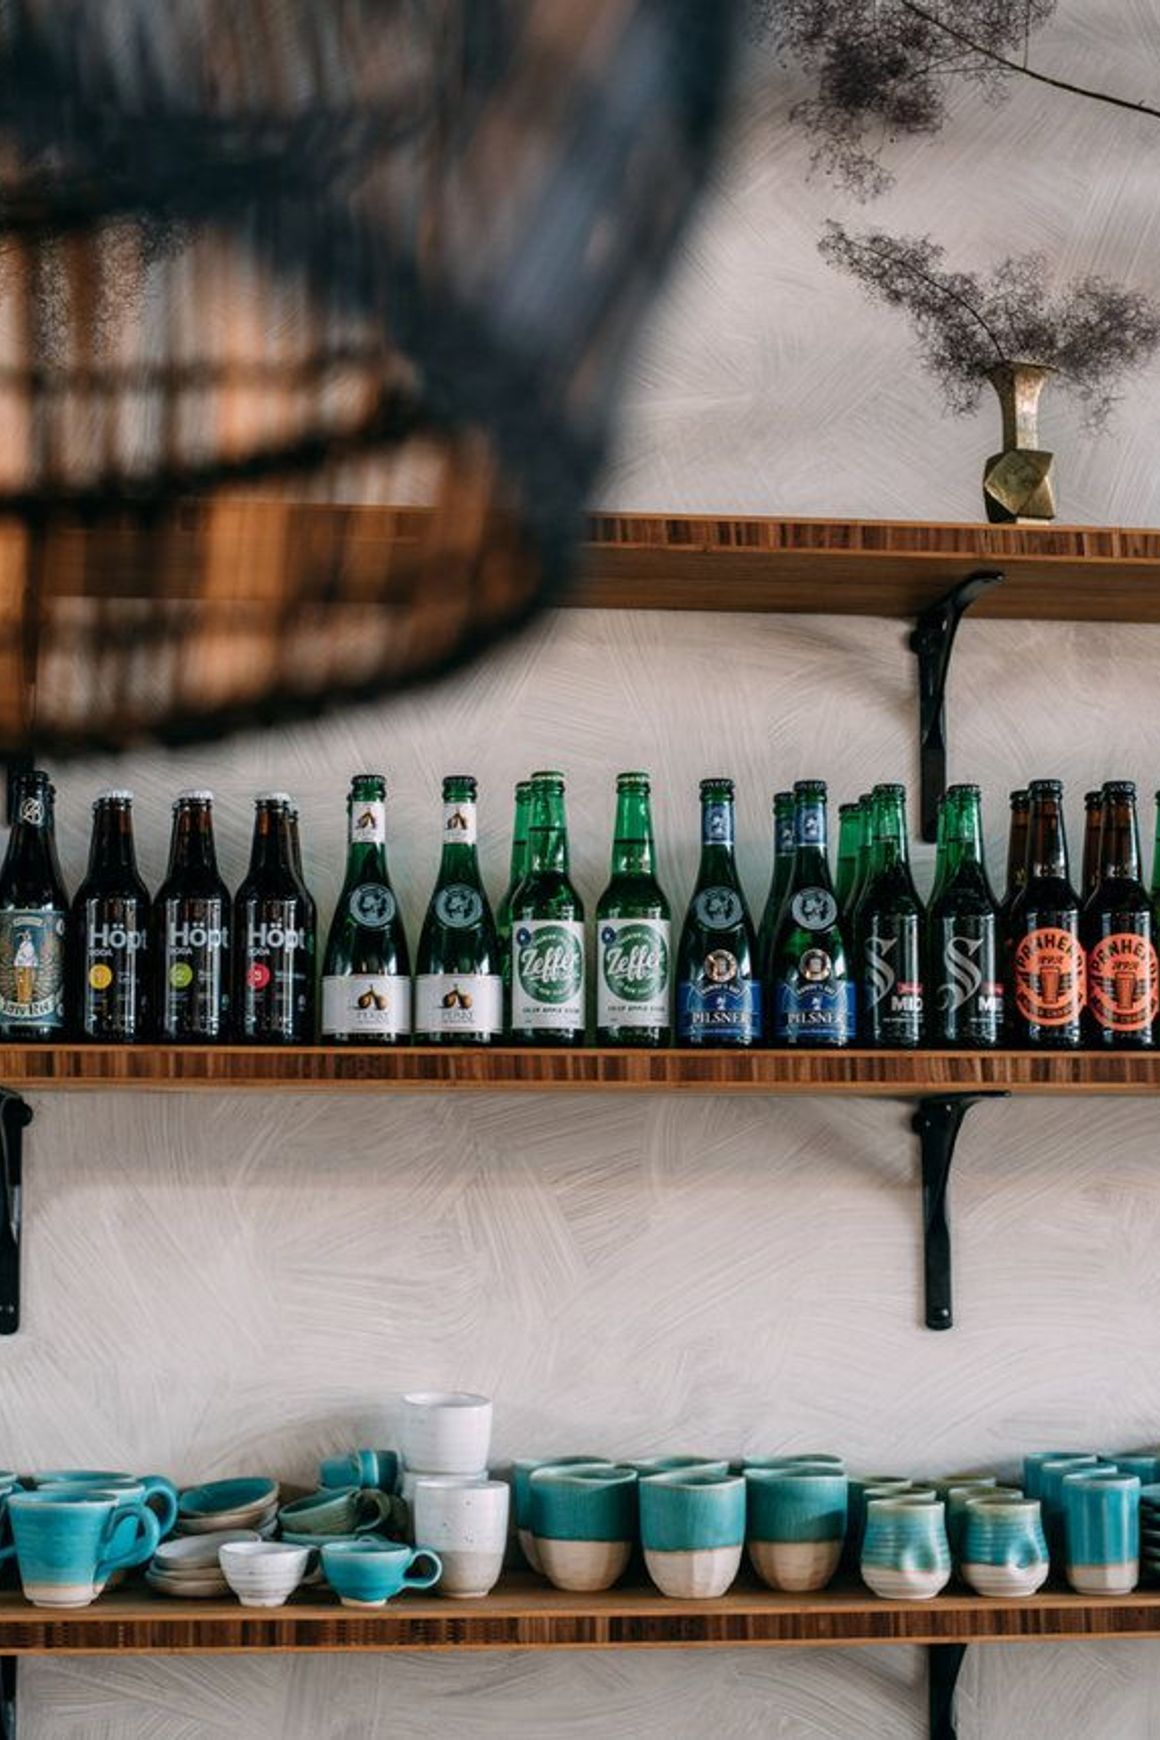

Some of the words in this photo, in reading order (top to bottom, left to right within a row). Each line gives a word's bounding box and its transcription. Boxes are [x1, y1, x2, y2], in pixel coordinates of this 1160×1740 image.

[89, 922, 147, 954] Höpt
[169, 921, 229, 952] Höpt
[247, 922, 306, 953] Höpt
